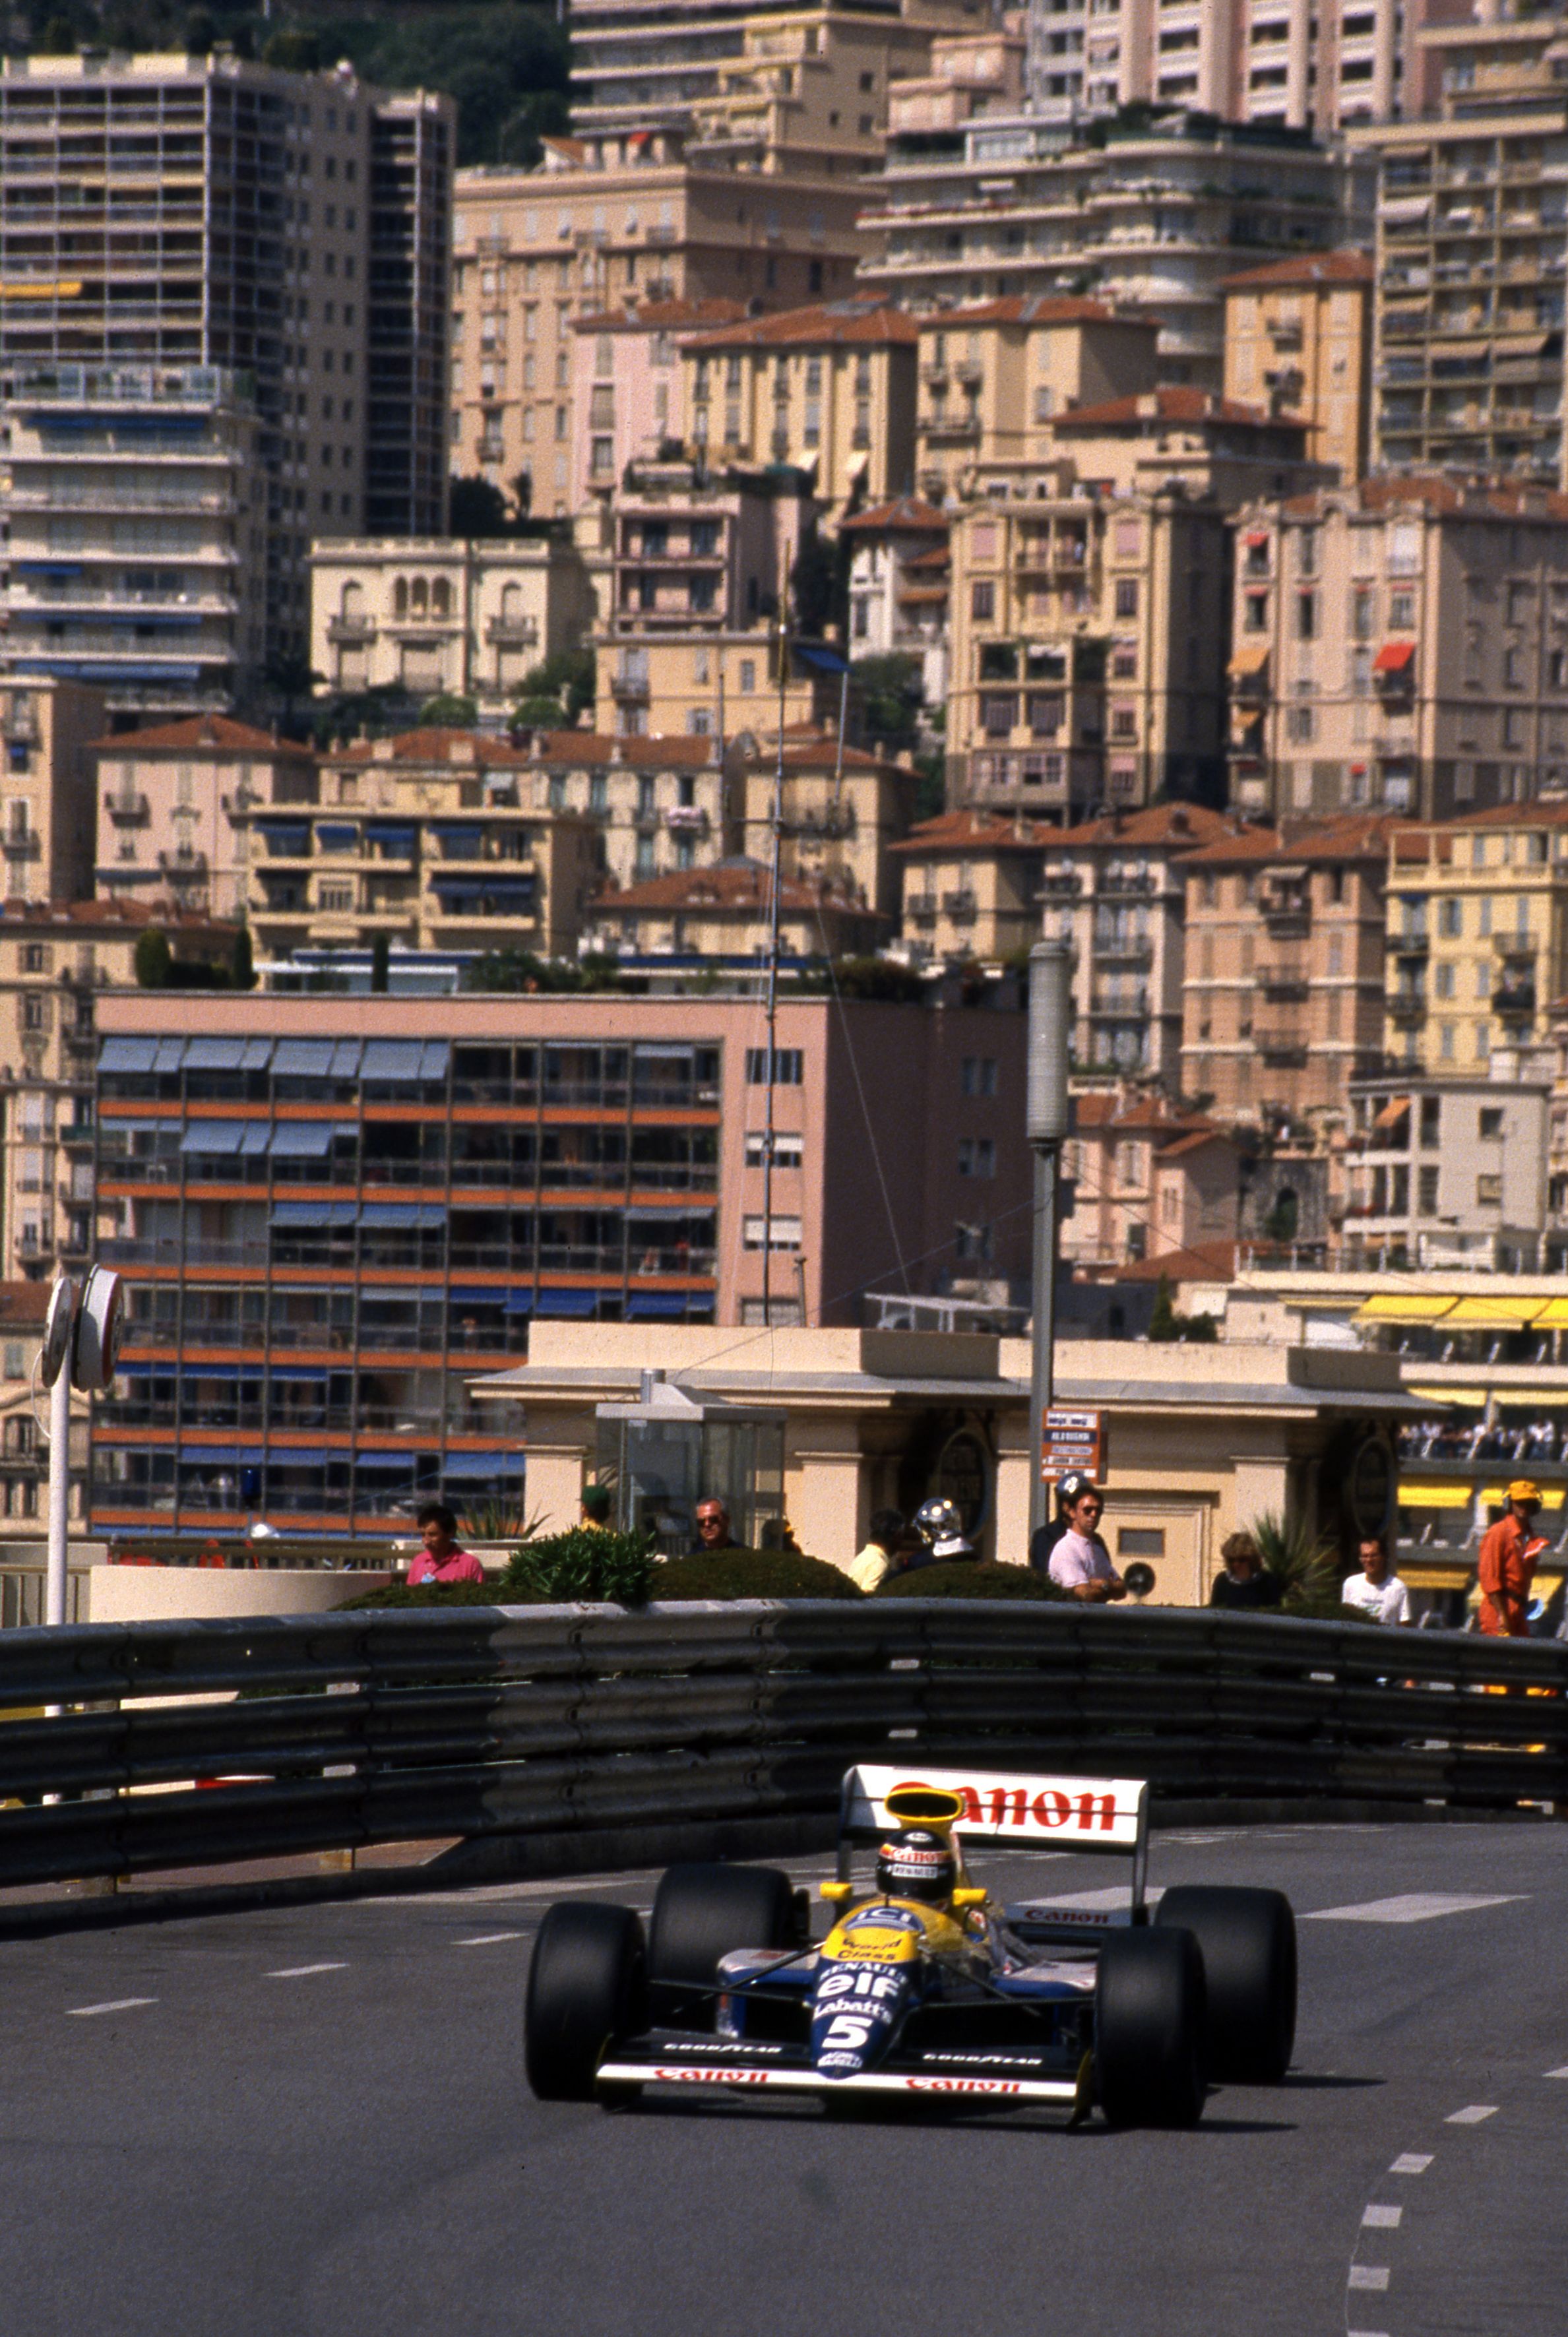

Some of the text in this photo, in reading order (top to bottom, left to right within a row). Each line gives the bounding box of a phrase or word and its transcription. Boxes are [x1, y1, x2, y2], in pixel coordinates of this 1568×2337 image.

[889, 1782, 1116, 1831] anon
[857, 1908, 912, 1923] ICI
[1025, 1910, 1109, 1924] Canon
[842, 1938, 902, 1950] World
[837, 1950, 896, 1960] Class
[817, 1971, 899, 1999] elf
[813, 1997, 893, 2026] Labatt's
[821, 2015, 874, 2049] 5
[664, 2043, 783, 2053] GOODYEAR
[923, 2053, 1043, 2065] GOODYEAR
[654, 2068, 770, 2083] Canon
[905, 2078, 1021, 2094] Canon
